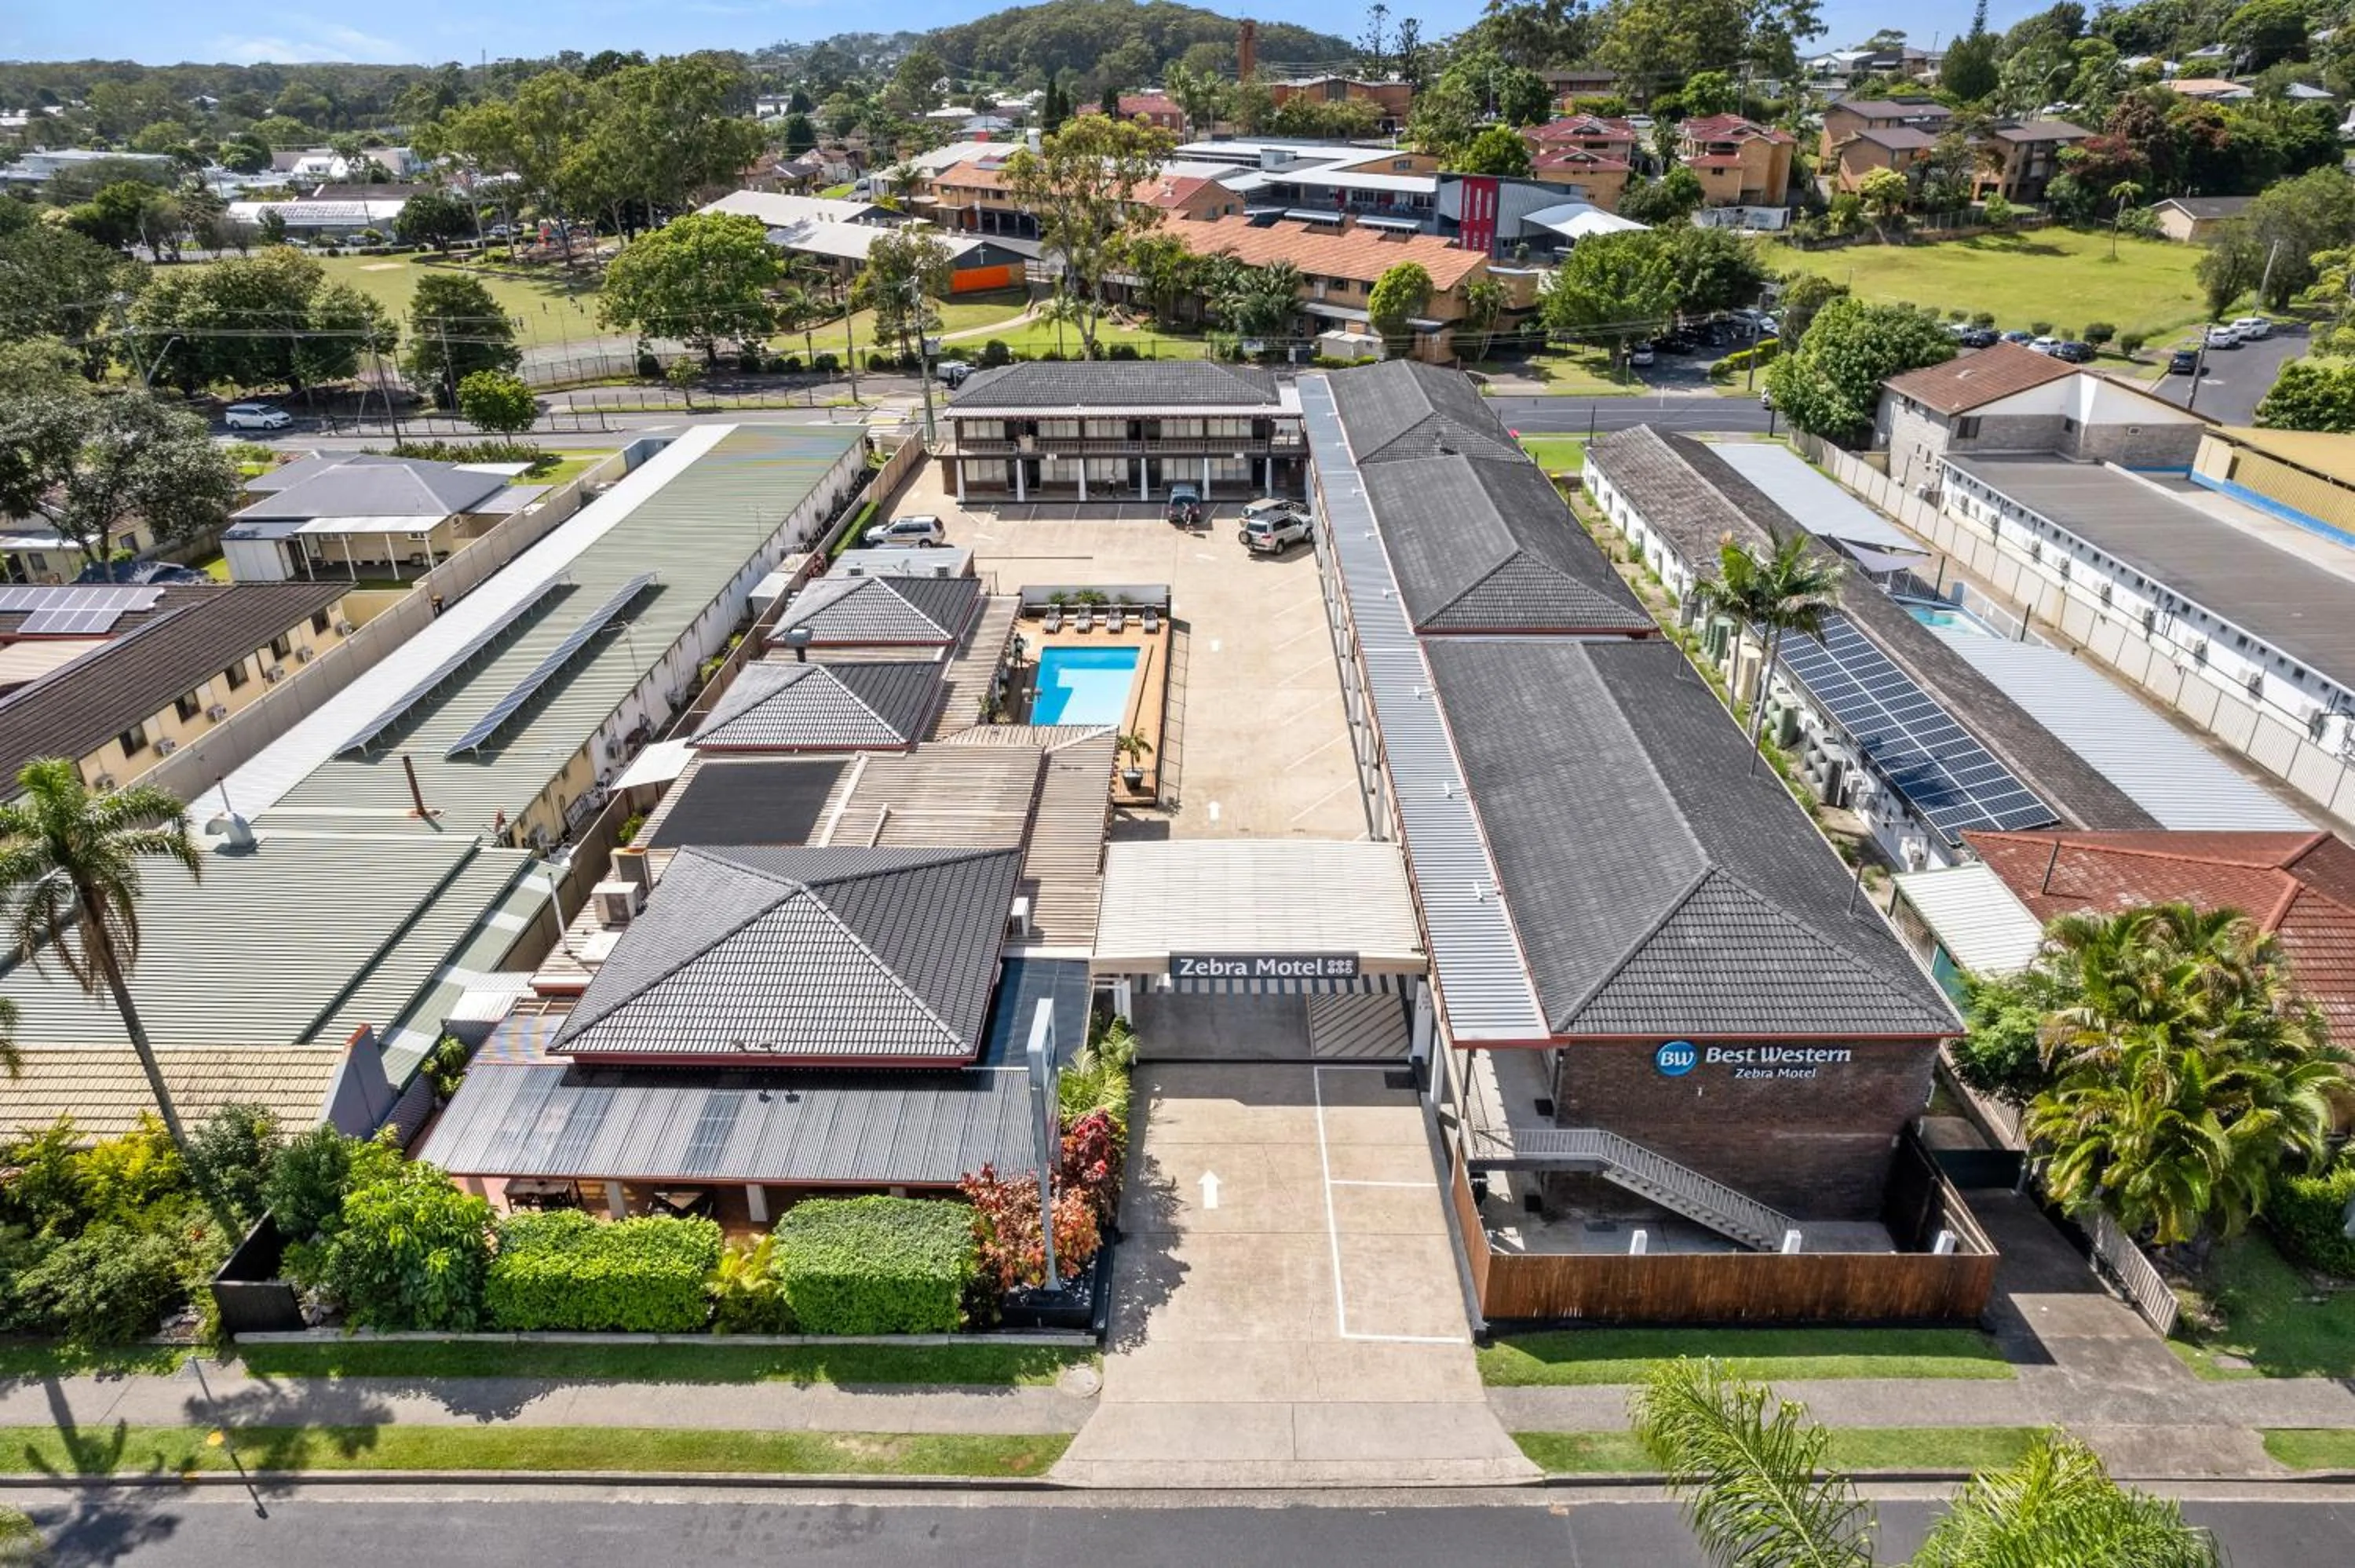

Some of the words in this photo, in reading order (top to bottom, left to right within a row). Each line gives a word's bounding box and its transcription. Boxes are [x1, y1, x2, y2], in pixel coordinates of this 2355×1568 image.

[1179, 958, 1248, 976] Zebra
[1256, 957, 1323, 976] Motel
[1659, 1050, 1694, 1067] BW
[1705, 1046, 1756, 1063] Best
[1760, 1045, 1852, 1063] Western
[1734, 1067, 1774, 1080] Zebra
[1777, 1067, 1817, 1079] Motel
